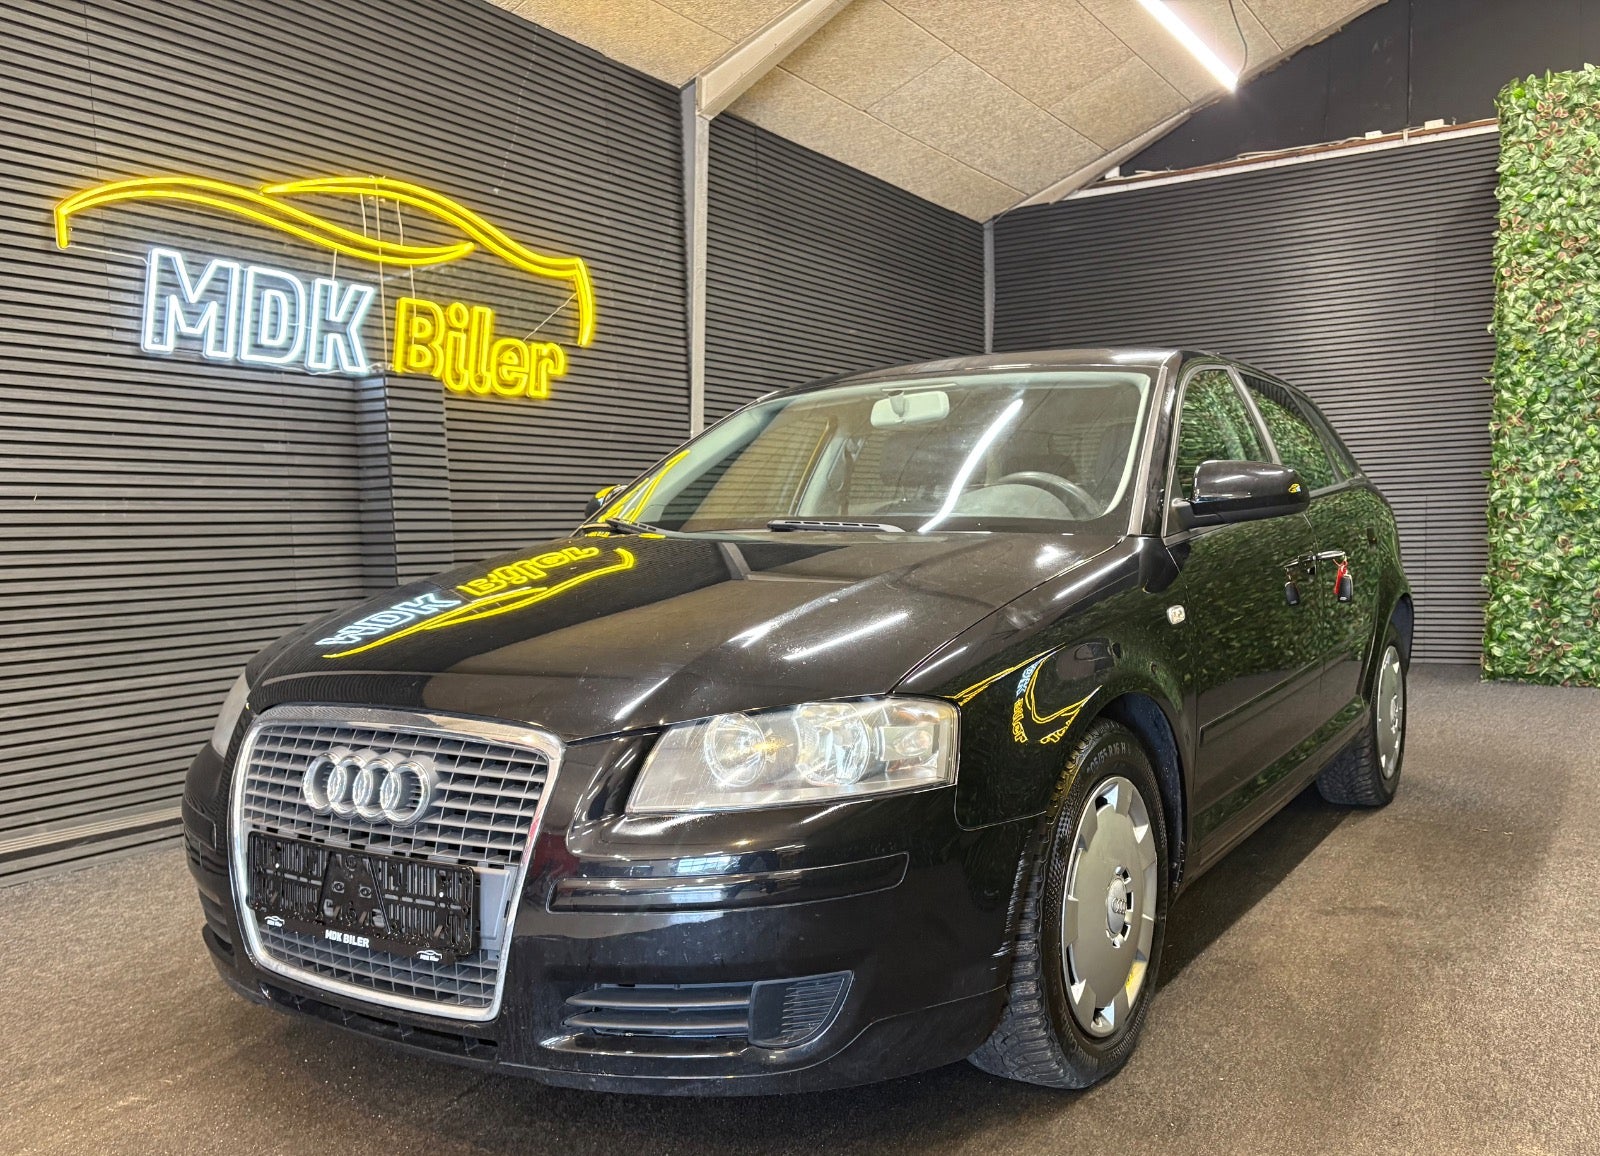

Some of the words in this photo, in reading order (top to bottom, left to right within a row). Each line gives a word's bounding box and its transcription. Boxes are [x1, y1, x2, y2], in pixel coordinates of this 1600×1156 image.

[142, 247, 375, 372] MDK
[393, 296, 567, 399] Biler
[325, 930, 342, 941] MDK
[343, 934, 369, 948] BILER
